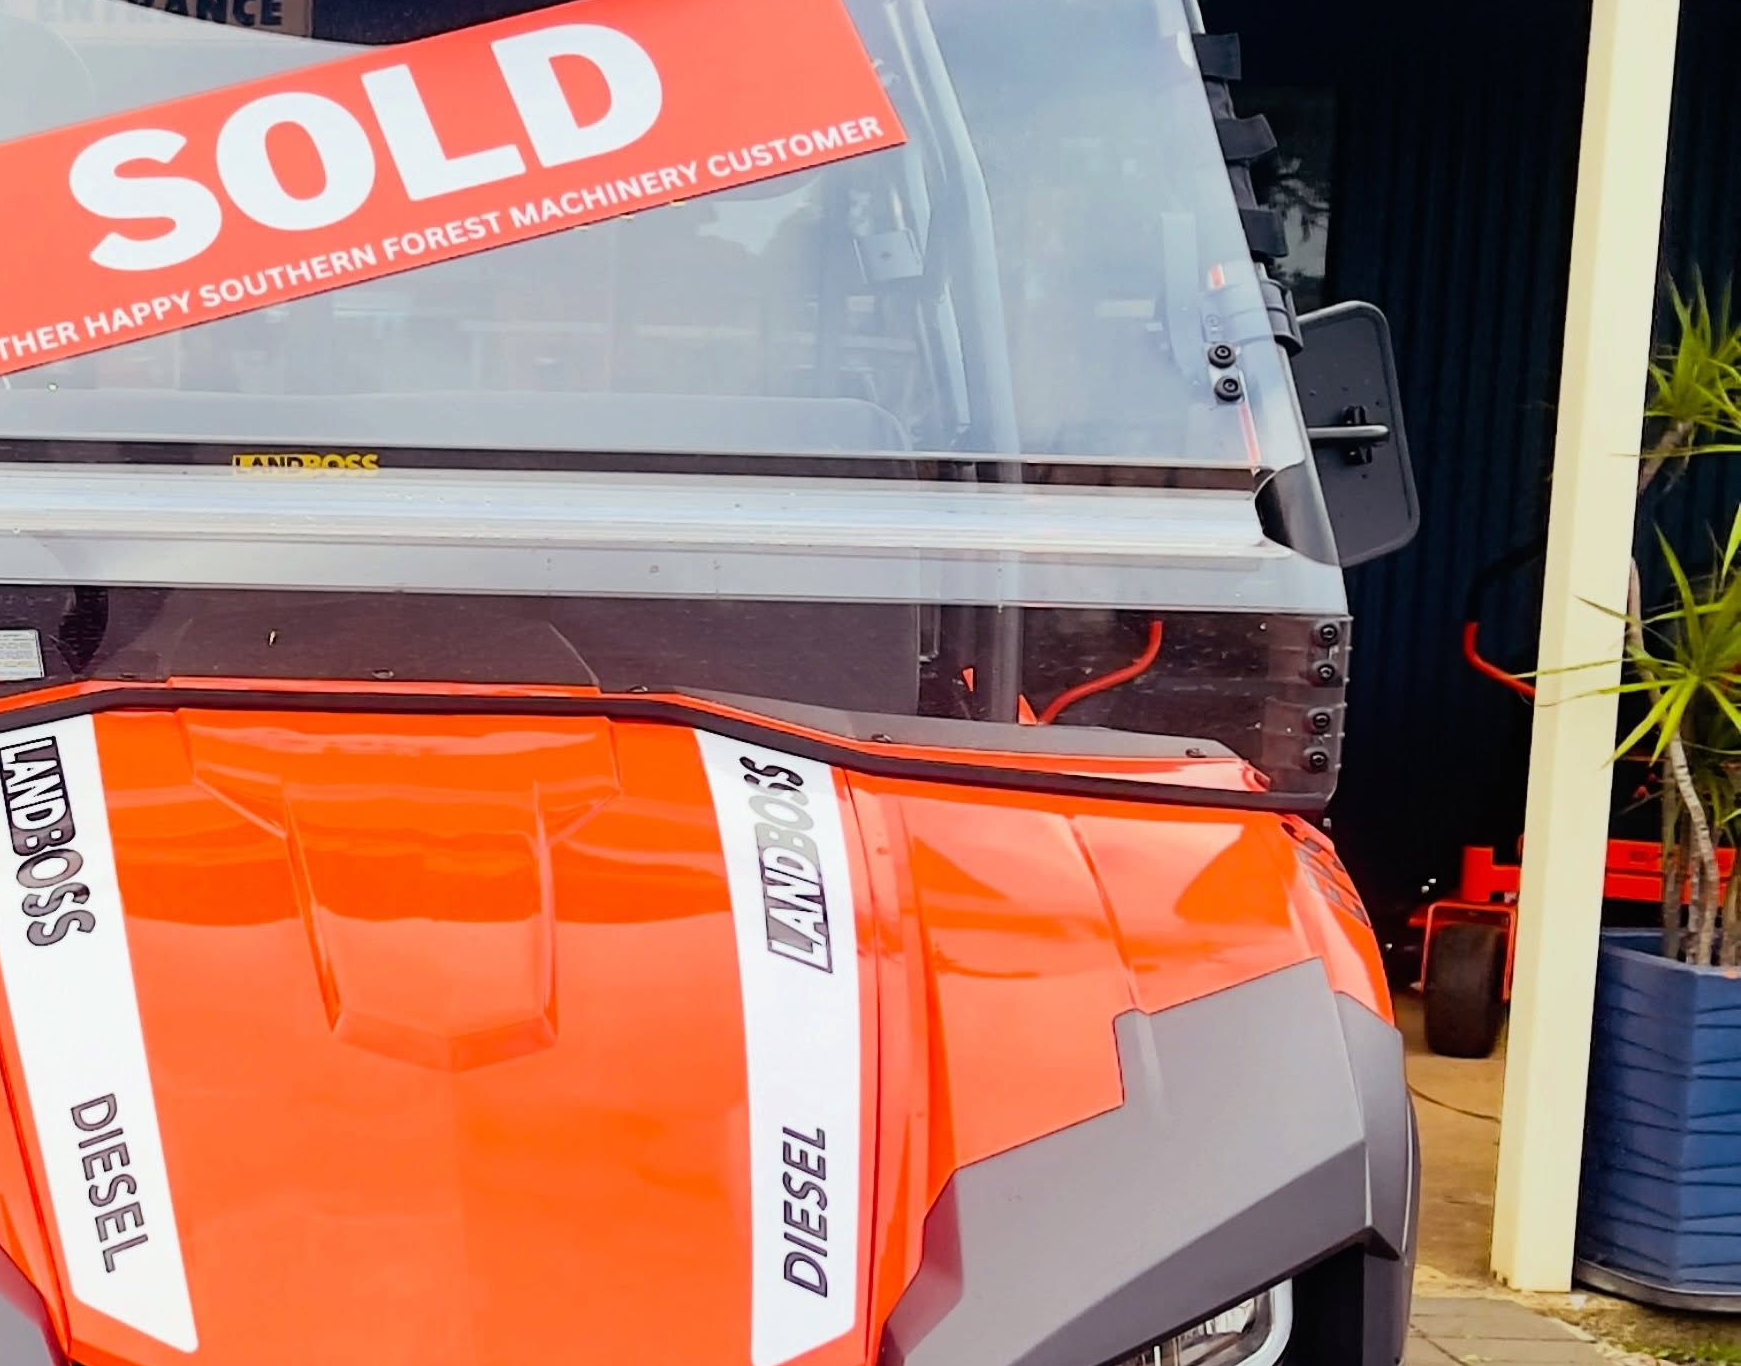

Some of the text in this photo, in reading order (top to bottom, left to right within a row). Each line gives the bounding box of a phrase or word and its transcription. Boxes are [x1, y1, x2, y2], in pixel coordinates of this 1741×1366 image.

[69, 22, 663, 271] SOLD
[85, 289, 193, 341] HAPPY
[201, 245, 378, 309] SOUTHERN
[382, 211, 502, 263] FOREST
[511, 161, 700, 231] MACHINERY
[708, 114, 884, 181] CUSTOMER
[232, 453, 380, 475] LANDBOSS
[738, 755, 833, 975] LANDBOSS
[70, 1092, 151, 1275] DIESEL
[782, 1126, 828, 1297] DIESEL
